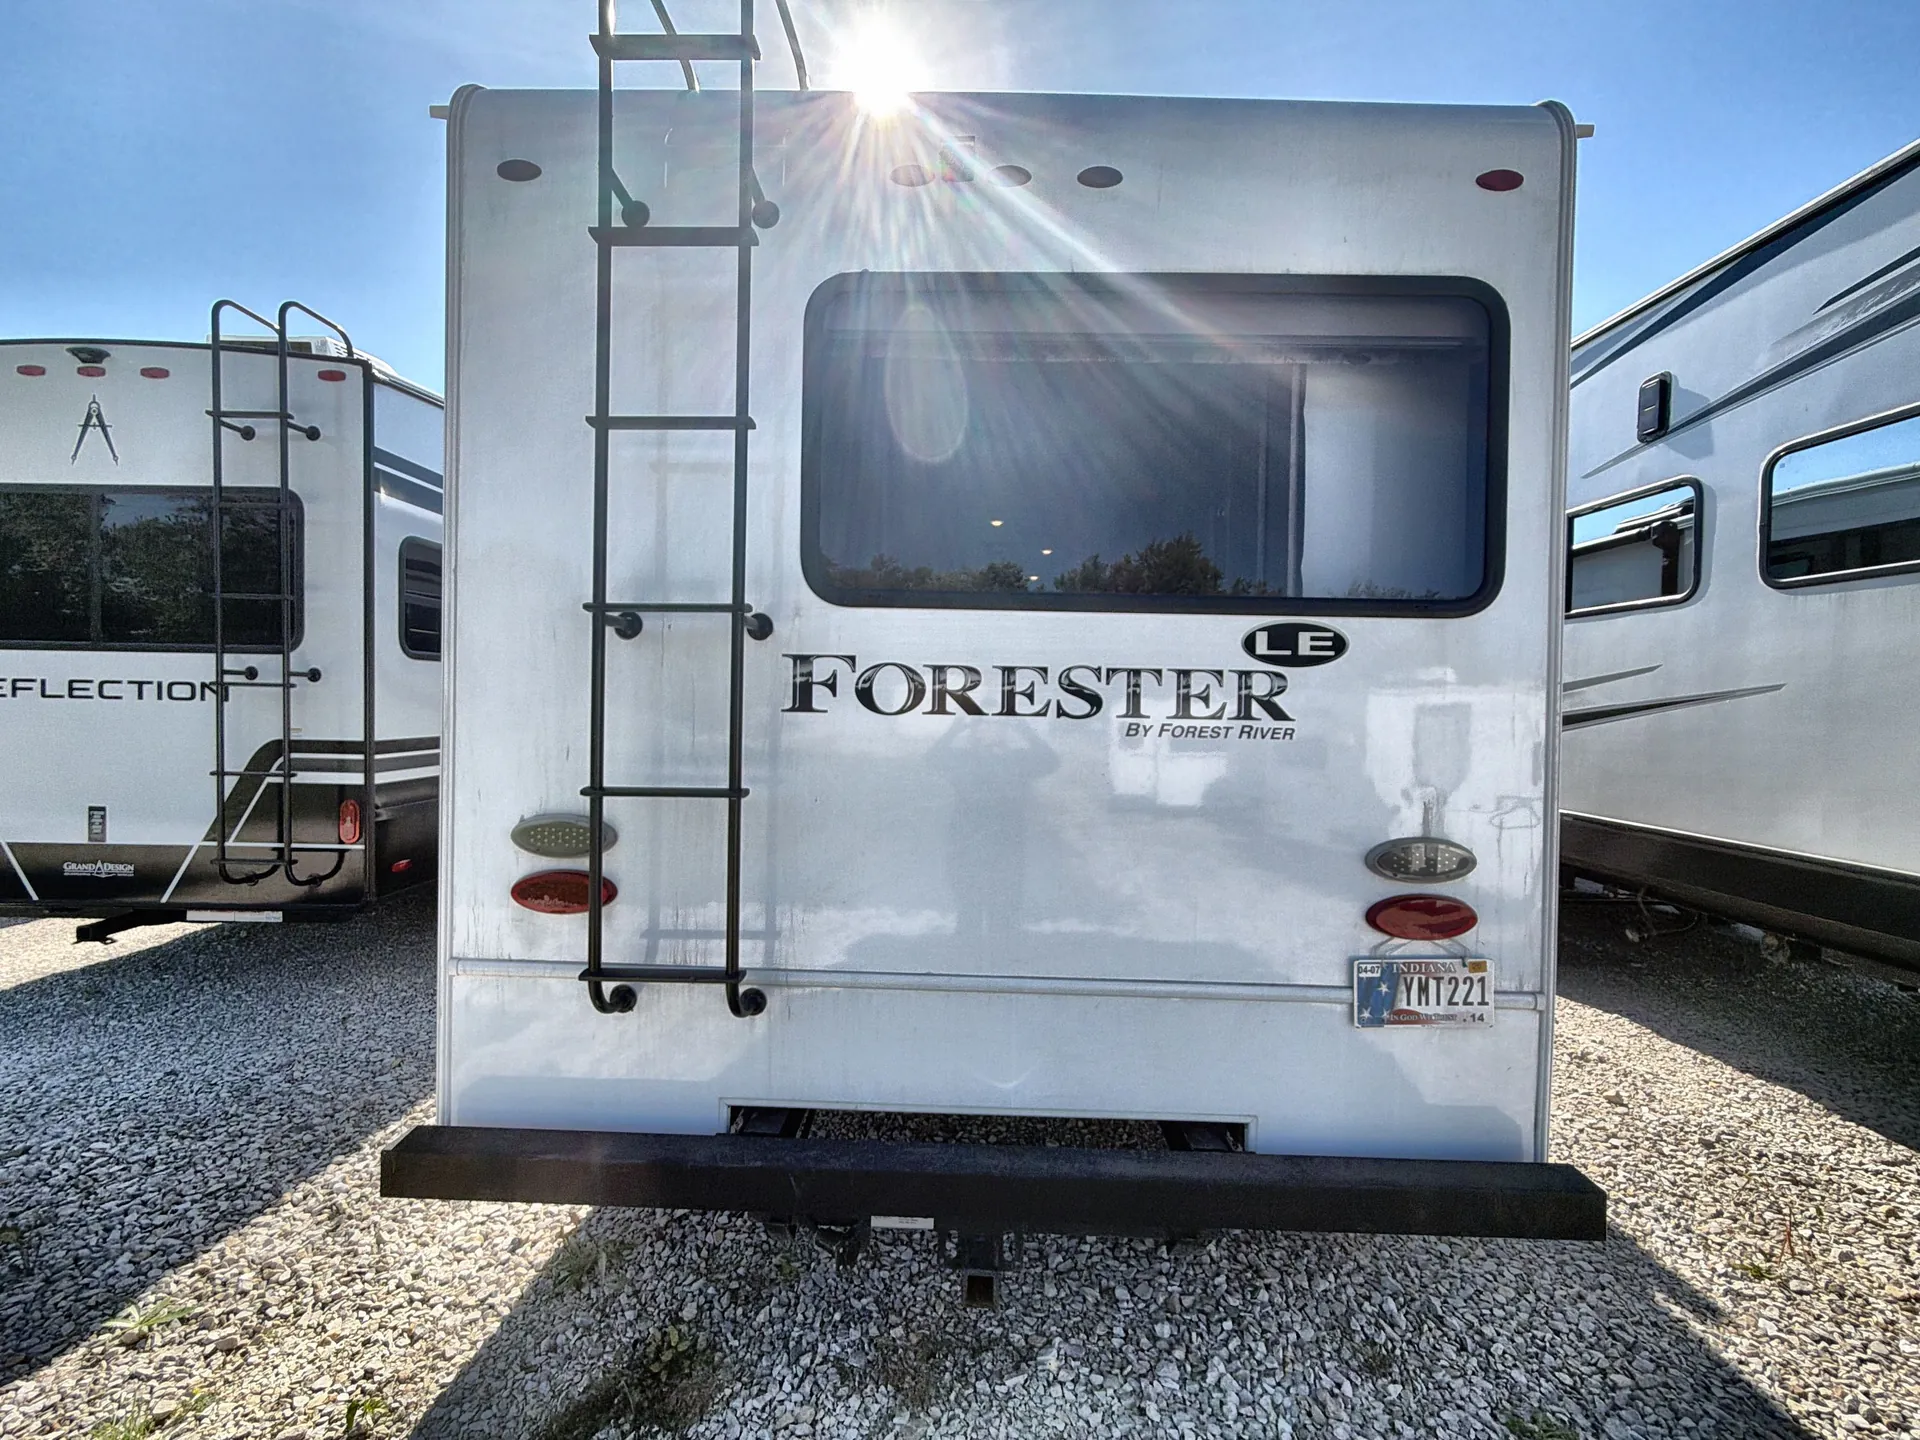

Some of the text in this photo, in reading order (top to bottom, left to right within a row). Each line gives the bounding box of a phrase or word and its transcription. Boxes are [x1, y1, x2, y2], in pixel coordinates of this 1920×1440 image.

[1255, 631, 1335, 656] LE
[0, 677, 230, 702] FLECTION
[781, 653, 1297, 722] FORESTER
[1125, 722, 1296, 741] BY FOREST RIVER
[62, 861, 135, 872] GRAND DESIGN
[1358, 965, 1380, 975] 04-07
[1392, 962, 1457, 974] INDIANA
[1403, 975, 1490, 1007] YMT221
